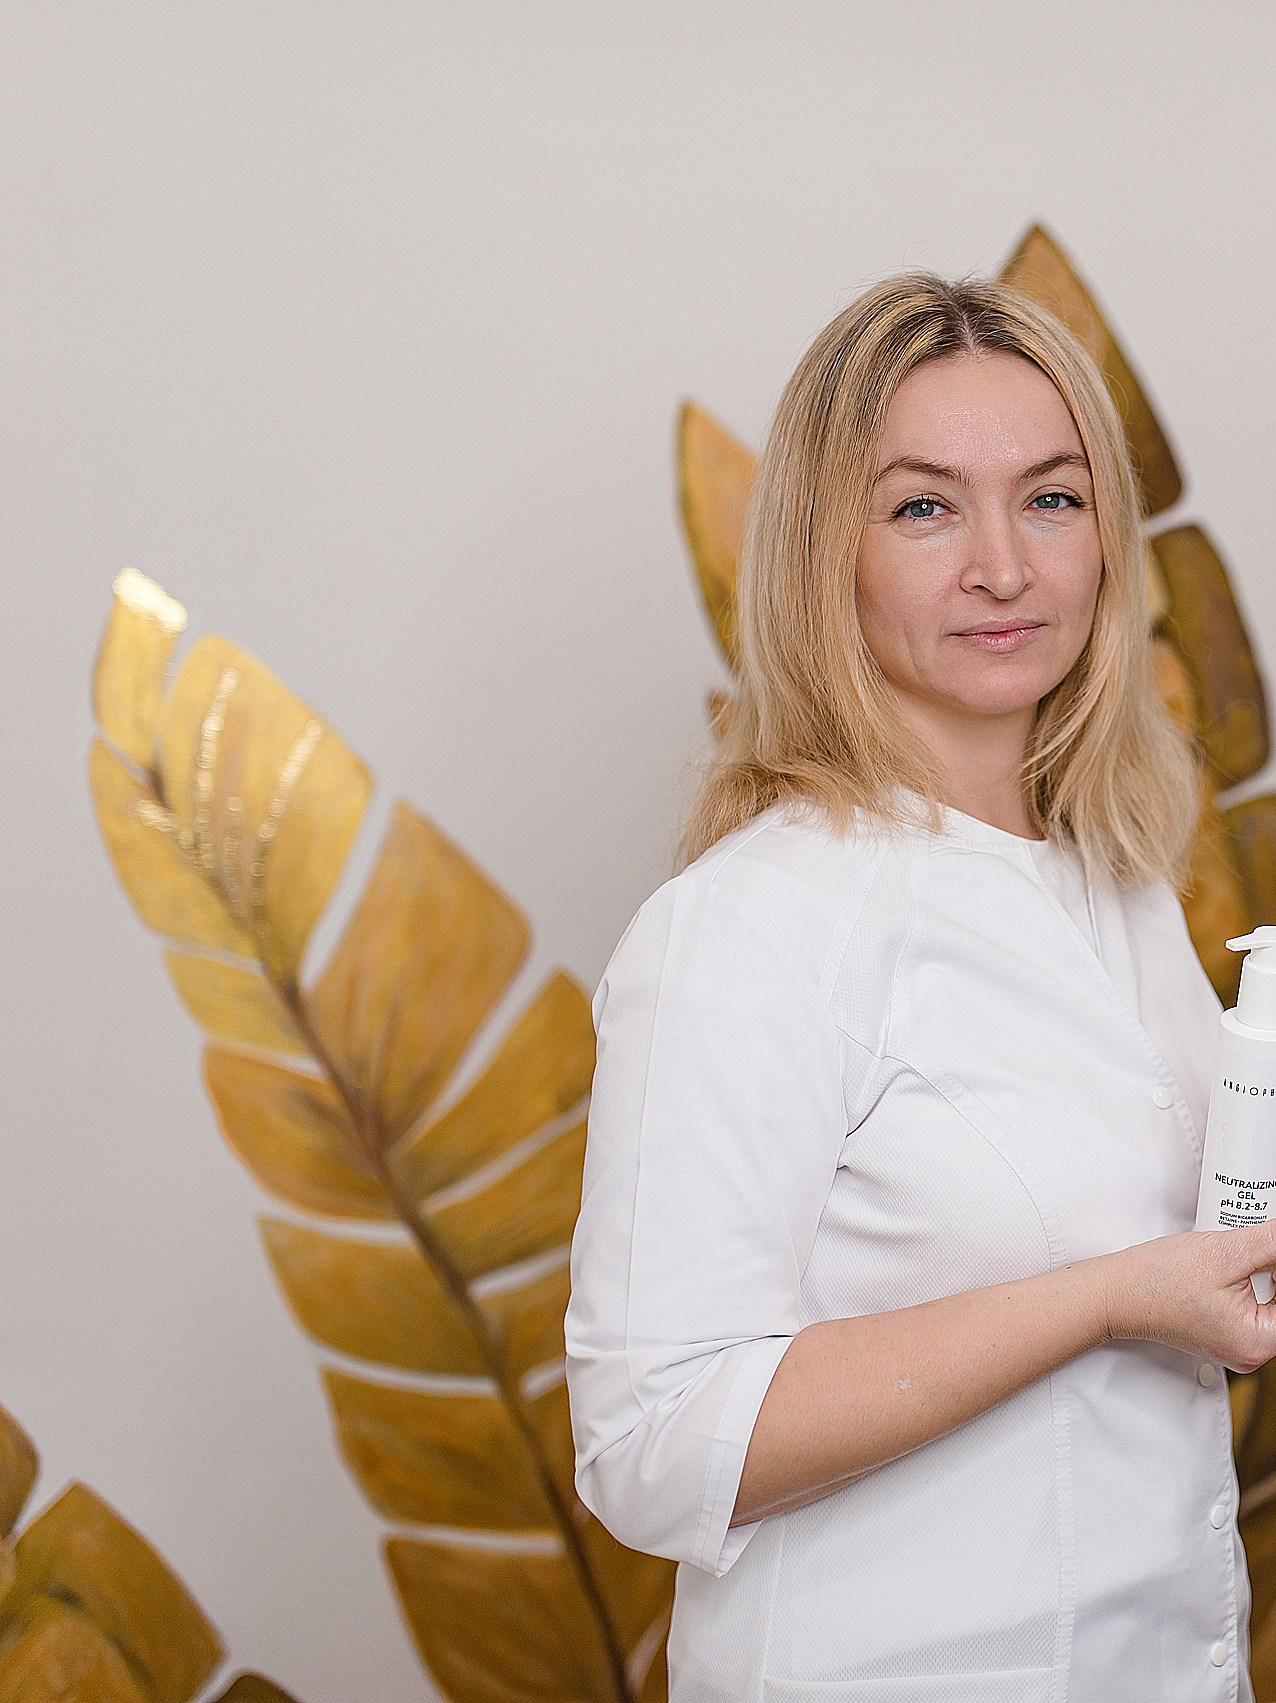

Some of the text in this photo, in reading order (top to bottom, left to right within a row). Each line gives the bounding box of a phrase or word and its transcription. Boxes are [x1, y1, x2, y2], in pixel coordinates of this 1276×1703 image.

[1237, 1191, 1256, 1200] GEL
[1220, 1199, 1268, 1211] pH 8.2-8.7
